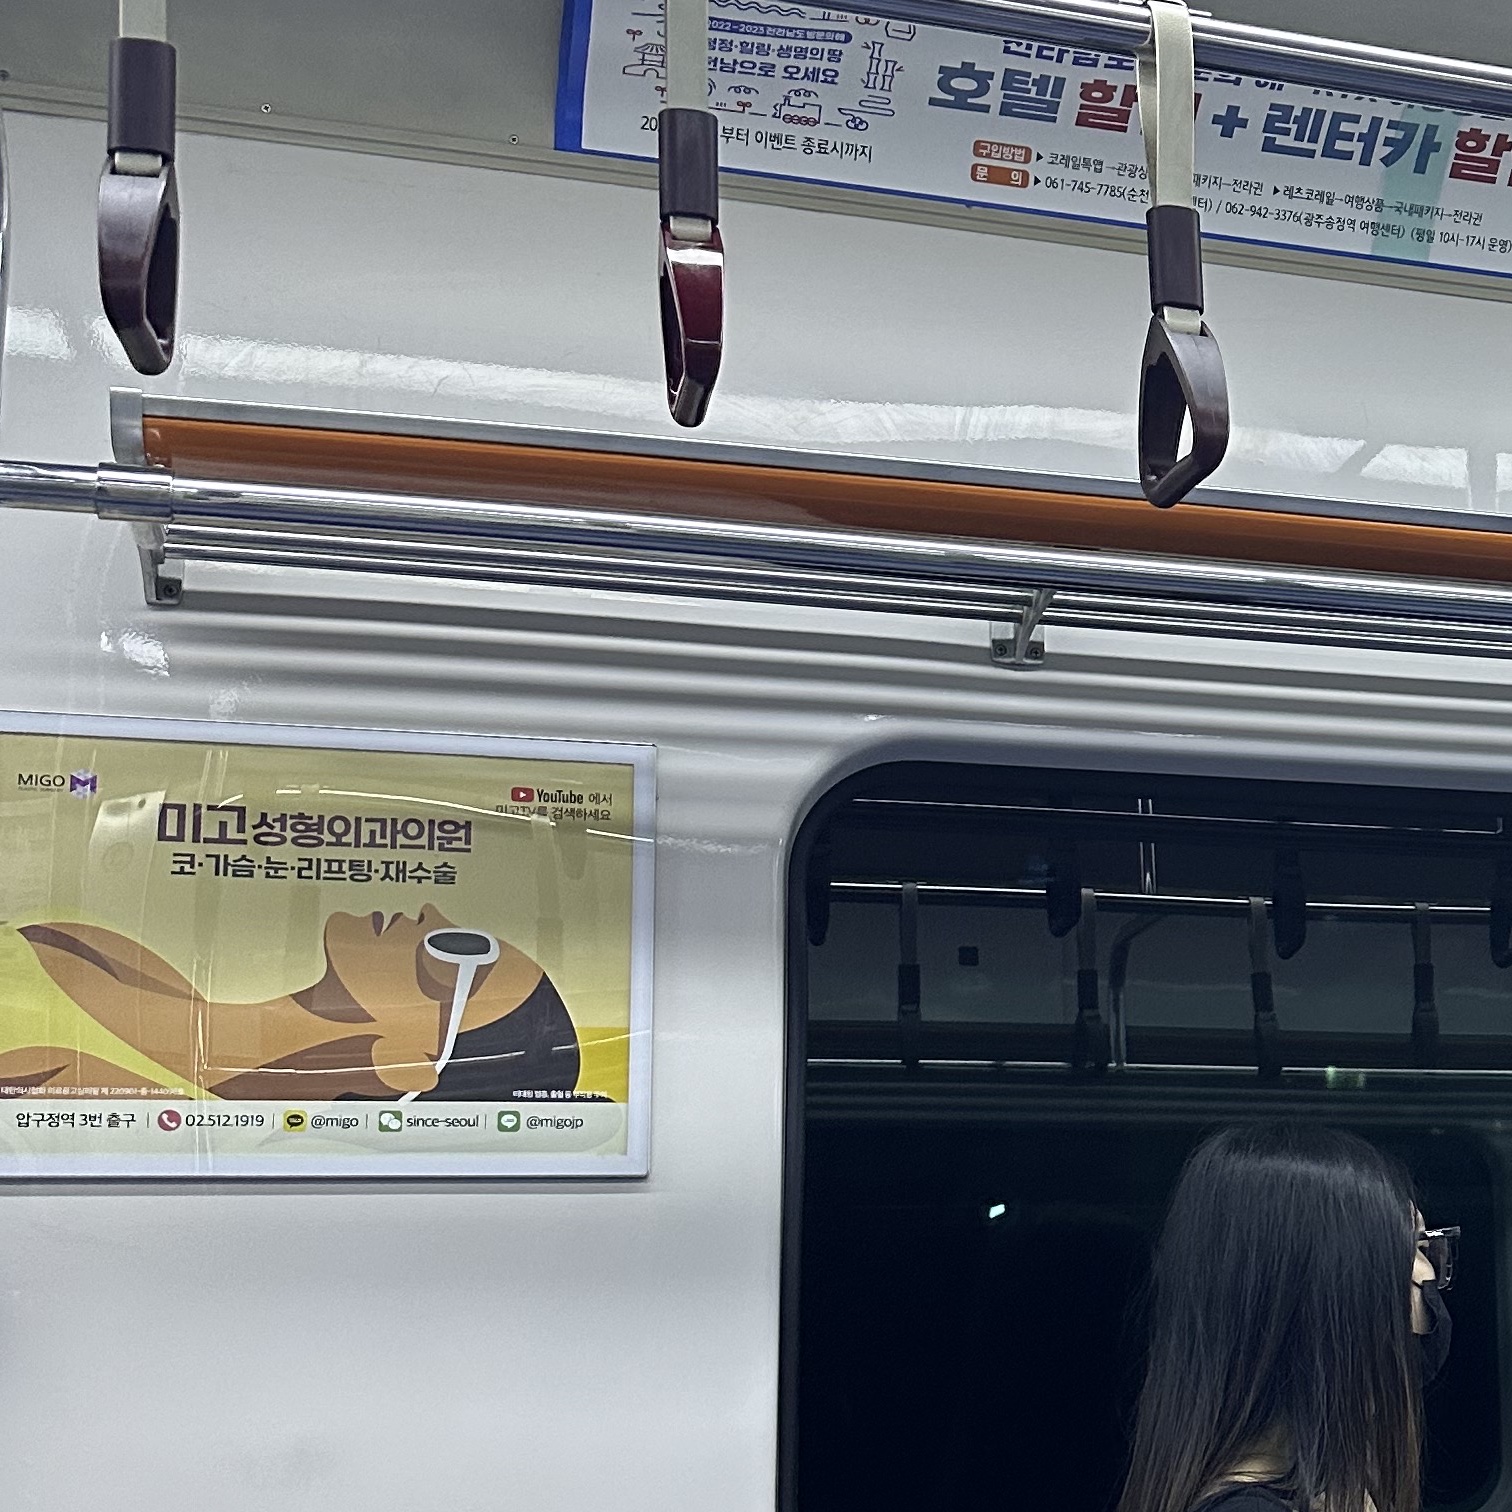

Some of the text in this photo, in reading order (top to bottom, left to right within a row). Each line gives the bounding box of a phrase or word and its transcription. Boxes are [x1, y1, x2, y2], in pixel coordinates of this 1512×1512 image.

[781, 64, 840, 86] 오세요
[928, 61, 1067, 123] 호텔
[1262, 102, 1442, 175] 렌터카
[720, 126, 749, 147] 부터
[754, 130, 798, 151] 이벤트
[801, 136, 873, 164] 종료시까지
[978, 141, 1026, 163] 구입방법
[17, 773, 66, 787] MIGO
[536, 788, 613, 806] YouTube 에서
[551, 806, 611, 821] 검색하세요
[16, 1112, 75, 1128] 압구정역
[79, 1112, 103, 1128] 3번
[106, 1112, 137, 1128] 출구
[310, 1114, 359, 1130] @migo
[406, 1114, 479, 1128] since-seoul
[526, 1114, 584, 1130] @migojp
